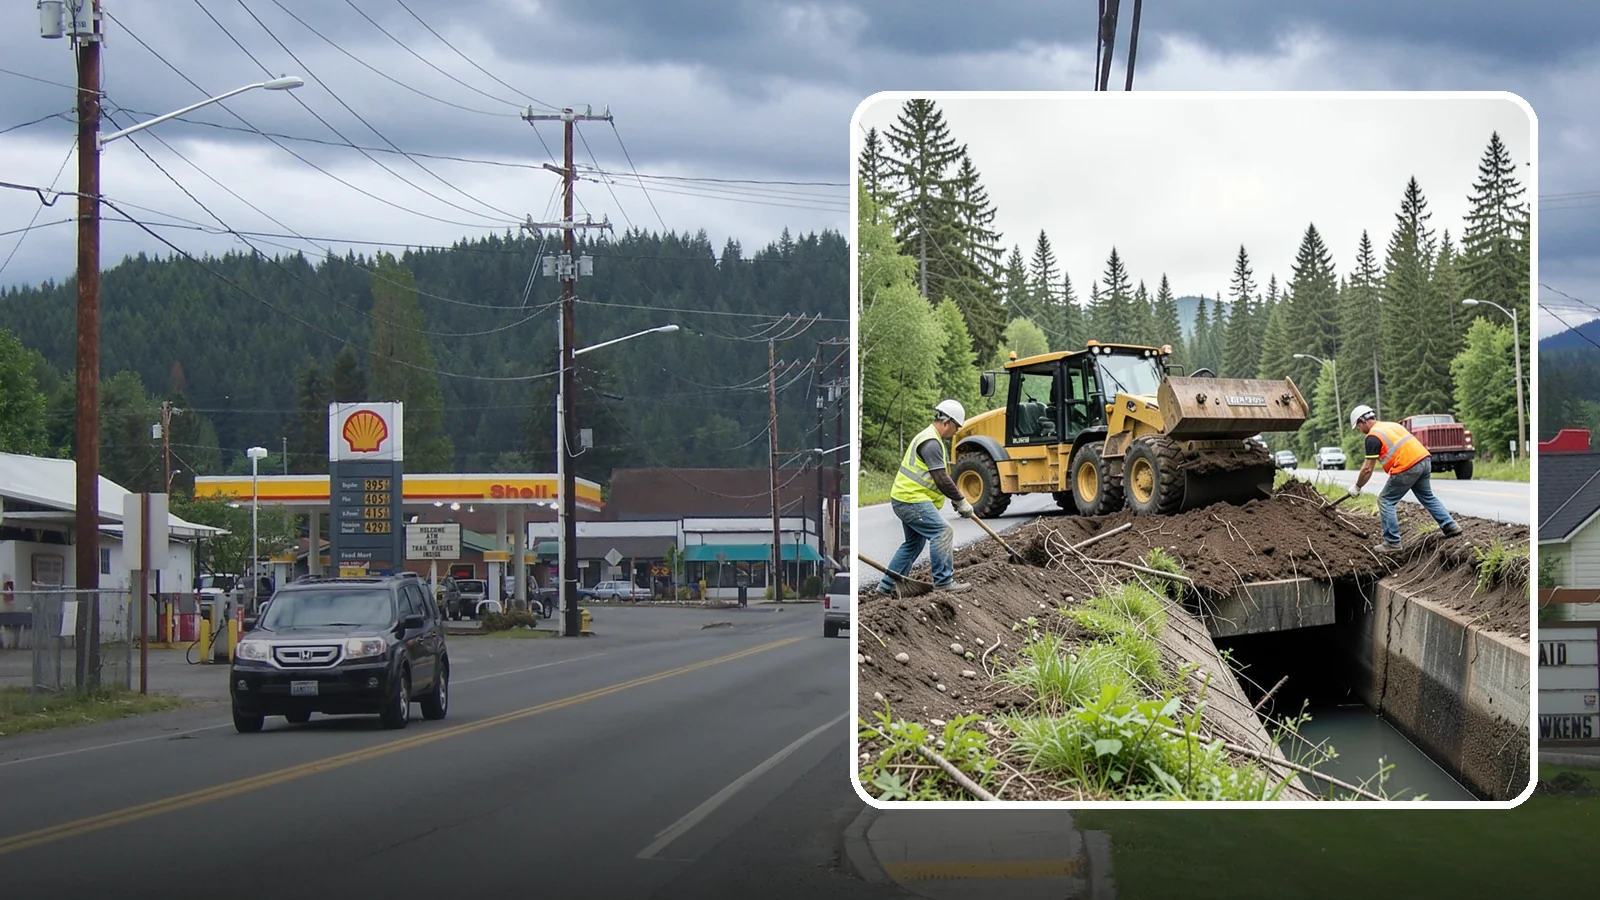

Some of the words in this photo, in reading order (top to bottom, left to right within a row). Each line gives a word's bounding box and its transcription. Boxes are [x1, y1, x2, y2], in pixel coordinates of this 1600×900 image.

[365, 480, 384, 490] 395
[490, 484, 547, 499] Shell
[365, 494, 384, 504] 405
[365, 508, 384, 518] 415
[365, 522, 384, 532] 429
[1538, 643, 1566, 666] AID
[1538, 716, 1592, 738] WKENS
